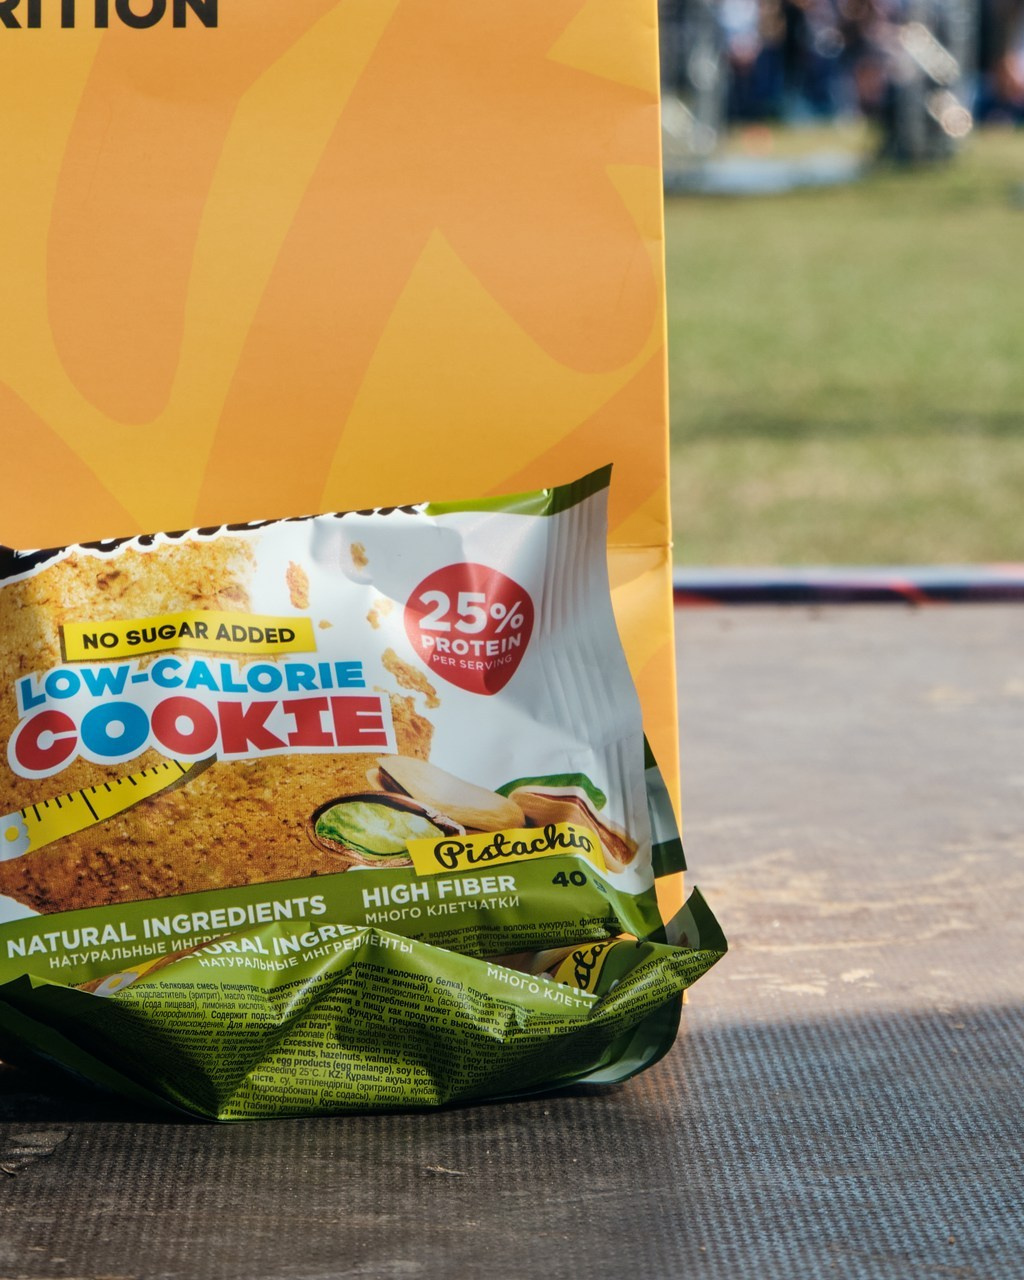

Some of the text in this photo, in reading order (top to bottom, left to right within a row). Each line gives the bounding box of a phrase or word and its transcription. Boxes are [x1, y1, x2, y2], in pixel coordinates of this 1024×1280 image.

[418, 589, 524, 634] 25%
[83, 621, 295, 650] NO SUGAR ADDED
[420, 633, 522, 657] PROTEIN
[432, 654, 513, 671] PER SERVING
[20, 658, 366, 711] LOW-CALORIE
[14, 696, 389, 772] COOKIE
[434, 823, 594, 870] Pistachio
[362, 875, 517, 908] HIGH FIBER
[552, 871, 587, 888] 40
[365, 896, 520, 925] МНОГО КЛЕТЧАТКИ
[6, 895, 327, 959] NATURAL INGREDIENTS
[49, 941, 167, 970] НАТУРАЛЬНЫЕ
[199, 933, 413, 972] НАТУРАЛЬНЫЕ ИНГРЕДИЕНТЫ
[197, 982, 219, 991] смесь
[387, 967, 433, 985] молочного
[487, 966, 540, 994] МНОГО
[283, 1039, 324, 1049] Excessive
[325, 1040, 381, 1056] consumption
[294, 1057, 332, 1070] products
